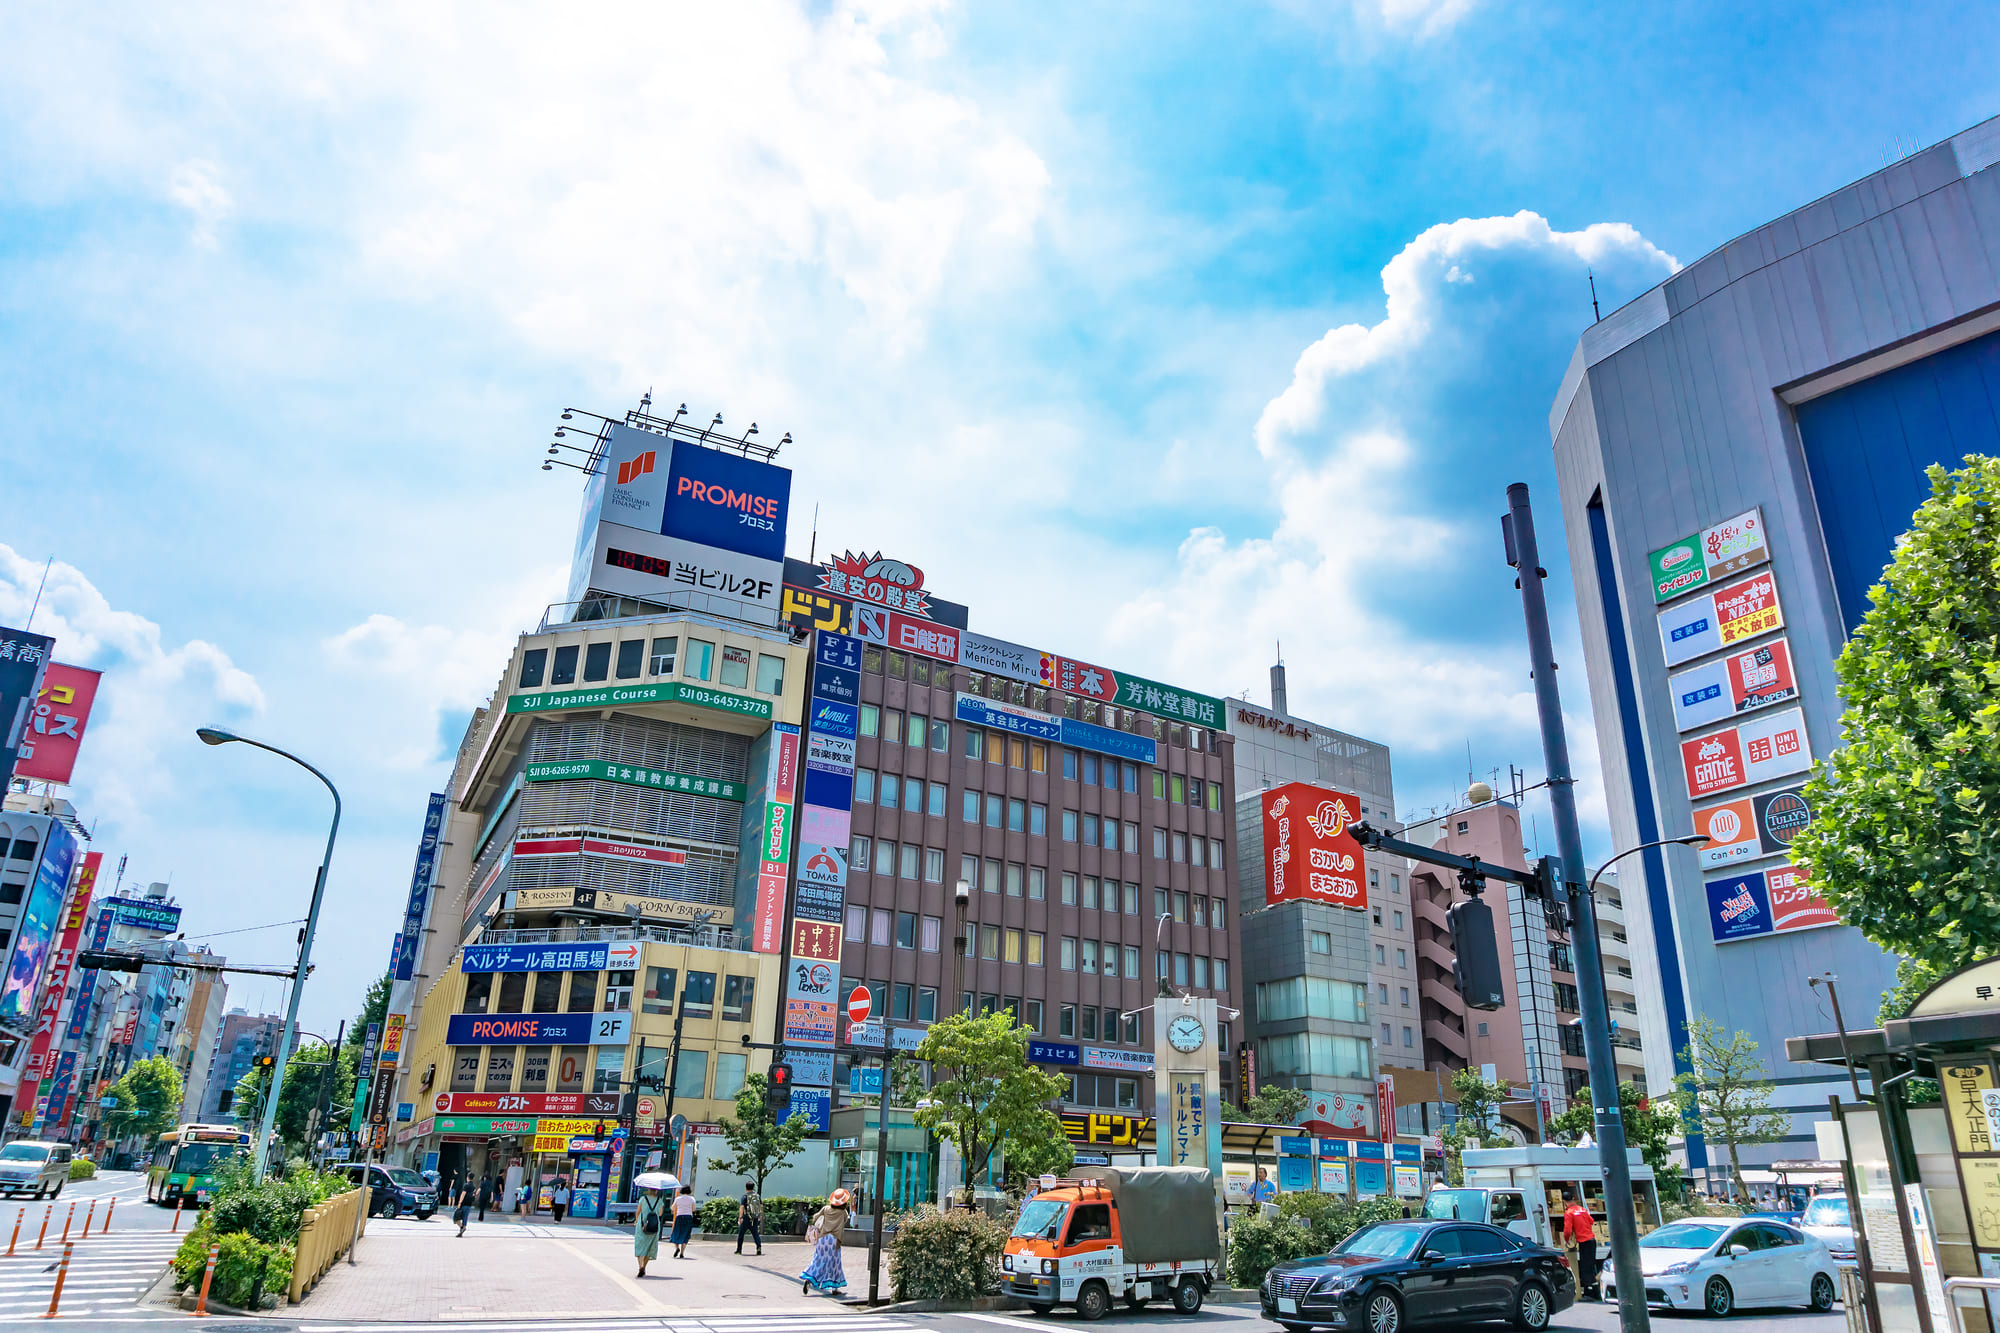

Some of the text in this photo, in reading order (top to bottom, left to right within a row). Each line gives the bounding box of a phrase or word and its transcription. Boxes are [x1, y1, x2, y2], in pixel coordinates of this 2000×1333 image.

[612, 493, 650, 507] CONSUMER
[613, 487, 633, 497] SMBC
[677, 476, 779, 519] PROMISE
[611, 499, 642, 511] FINANCE
[739, 514, 774, 532] プロミス
[674, 562, 773, 600] 当ビル2F
[1658, 569, 1702, 595] サイゼリヤ
[828, 569, 922, 612] 驚安の殿堂
[1728, 596, 1765, 620] NEXT
[1674, 622, 1705, 640] 改装中
[1724, 614, 1778, 642] 食べ放題
[901, 624, 956, 658] 日能研
[823, 650, 856, 667] ビル
[965, 640, 1024, 662] コンタクトレンズ
[965, 649, 1037, 677] Menicon Miru
[1062, 660, 1075, 671] 5F
[1061, 671, 1075, 681] 4F
[1079, 668, 1104, 696] 本
[1061, 680, 1075, 690] 3F
[523, 687, 657, 708] SJI Japanese Course
[679, 687, 768, 714] SJI 03-6457-3778
[1125, 681, 1215, 724] 芳林堂書店
[1685, 687, 1718, 704] 改装中
[1763, 689, 1788, 704] OPEN
[960, 697, 986, 712] AEON
[985, 711, 1060, 738] 英会話イーオン
[1238, 708, 1313, 742] ホテルサンルート
[824, 738, 852, 752] ヤマハ
[1750, 740, 1769, 752] ユニ
[1776, 732, 1794, 744] UNI
[810, 747, 852, 764] 音楽教室
[1751, 750, 1770, 762] クロ
[1778, 742, 1798, 754] QLO
[529, 764, 590, 777] SJI 03-6265-9570
[1694, 755, 1736, 785] GAME
[606, 765, 733, 796] 日本語教師養成講座
[1698, 776, 1738, 791] TAITO STATION
[1714, 814, 1734, 834] 100
[1776, 820, 1801, 830] COFFEE
[768, 806, 785, 860] サイゼリヤ
[608, 845, 647, 858] 三井のリハウス
[1309, 848, 1355, 872] おかしの
[1710, 847, 1749, 860] Can Do
[767, 863, 779, 874] B1
[806, 870, 838, 882] TOMAS
[401, 812, 440, 962] カラオケの鉄人
[1310, 872, 1358, 898] まちおか
[1770, 872, 1796, 890] 日産
[67, 868, 96, 929] パチンコ
[531, 891, 572, 900] ROSSINI
[577, 893, 593, 904] 4F
[1722, 891, 1750, 910] VIE DE
[118, 905, 178, 923] 東進ハイスクール
[636, 900, 676, 914] CORN
[1720, 899, 1755, 922] FRANCE
[465, 950, 606, 969] ベルサール高田馬場
[610, 960, 635, 968] 徒歩5分
[37, 948, 75, 1033] エスパス
[472, 1021, 539, 1038] PROMISE
[542, 1027, 567, 1037] プロミス
[600, 1020, 622, 1037] 2F
[860, 1034, 920, 1048] Menicn Miru
[1099, 1050, 1155, 1063] ヤマハ音楽教室
[525, 1068, 546, 1081] 利息
[561, 1056, 582, 1083] 0円
[497, 1096, 530, 1111] ガスト
[792, 1090, 819, 1101] AEON
[604, 1102, 615, 1111] 2F
[790, 1101, 819, 1113] 英会話
[1960, 1080, 1992, 1152] 早大正門
[490, 1120, 530, 1132] サイゼリヤ
[547, 1120, 591, 1132] おたからや
[535, 1137, 565, 1150] 高価買取
